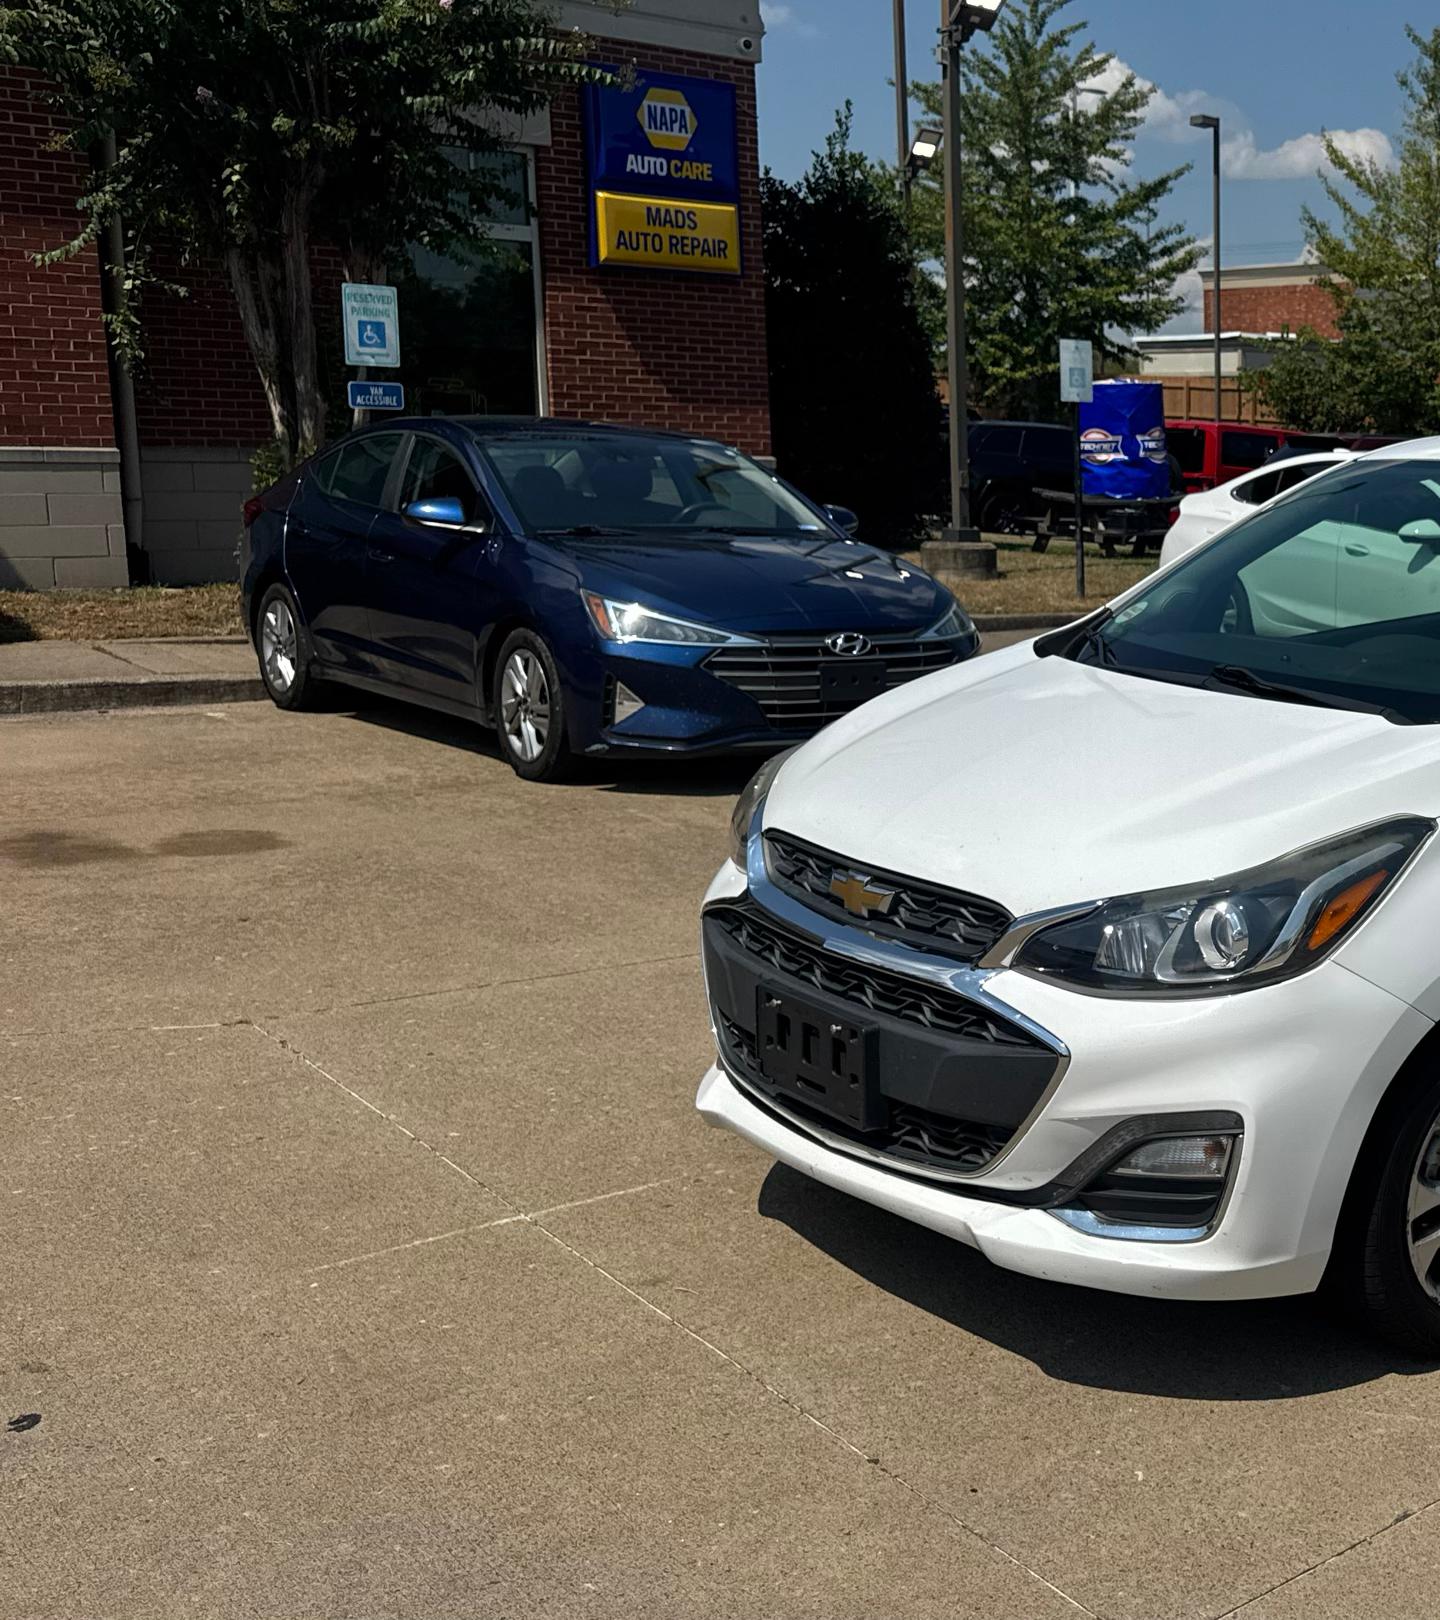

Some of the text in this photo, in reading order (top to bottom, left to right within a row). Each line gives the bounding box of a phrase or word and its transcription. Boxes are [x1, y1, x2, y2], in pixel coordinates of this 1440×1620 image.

[647, 103, 689, 135] NAPA
[626, 153, 713, 182] AUTO CARE
[646, 206, 698, 231] MADS
[615, 230, 728, 259] AUTO REPAIR
[346, 293, 392, 304] RESERVED
[351, 305, 391, 317] PARKING
[369, 386, 384, 396] VAN
[356, 395, 398, 407] ACCESSIBLE
